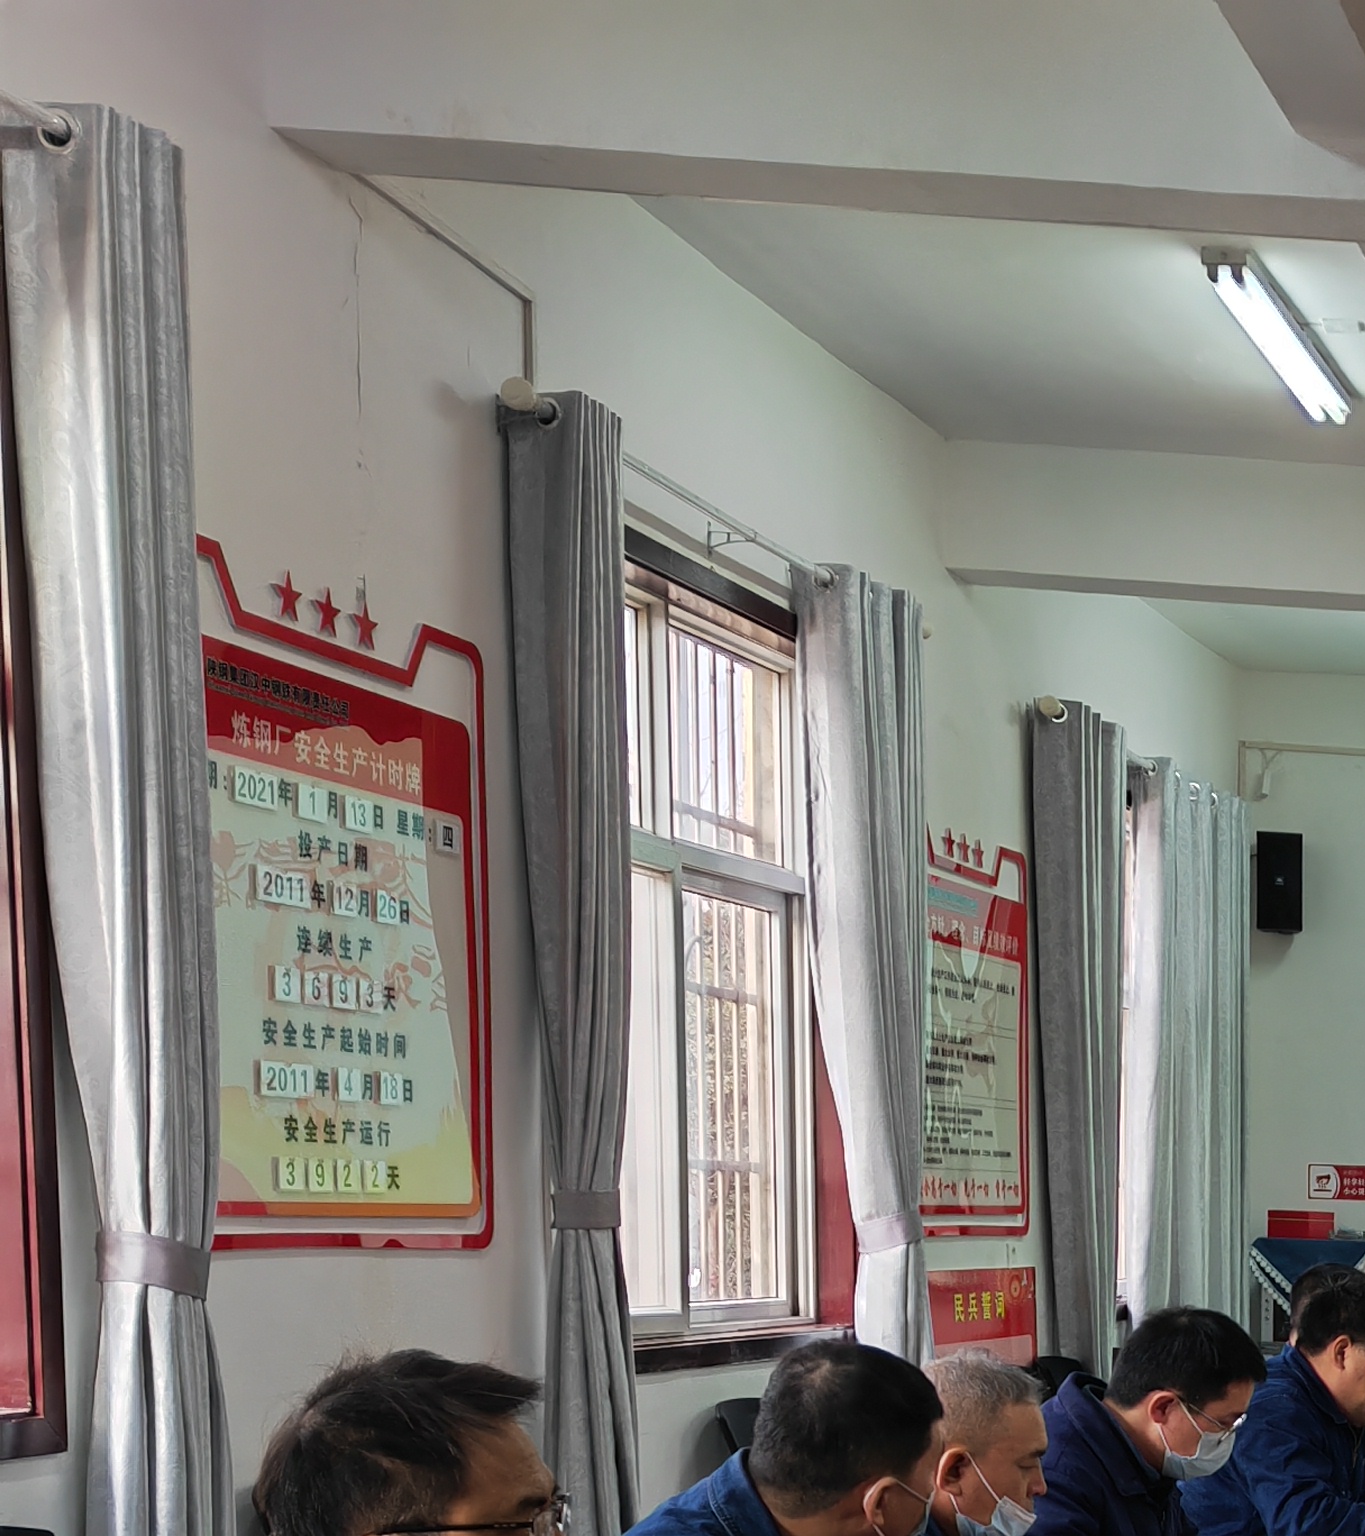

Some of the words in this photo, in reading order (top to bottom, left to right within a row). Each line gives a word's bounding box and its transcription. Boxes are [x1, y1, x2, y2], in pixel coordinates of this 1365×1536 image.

[230, 709, 423, 797] 炼钢厂安全生产计时牌
[298, 829, 369, 872] 投产日期
[296, 925, 373, 963] 连续生产
[261, 1017, 407, 1060] 安全生产起始时间
[283, 1114, 392, 1148] 安全生产运行
[953, 1290, 1005, 1322] 民兵誓词
